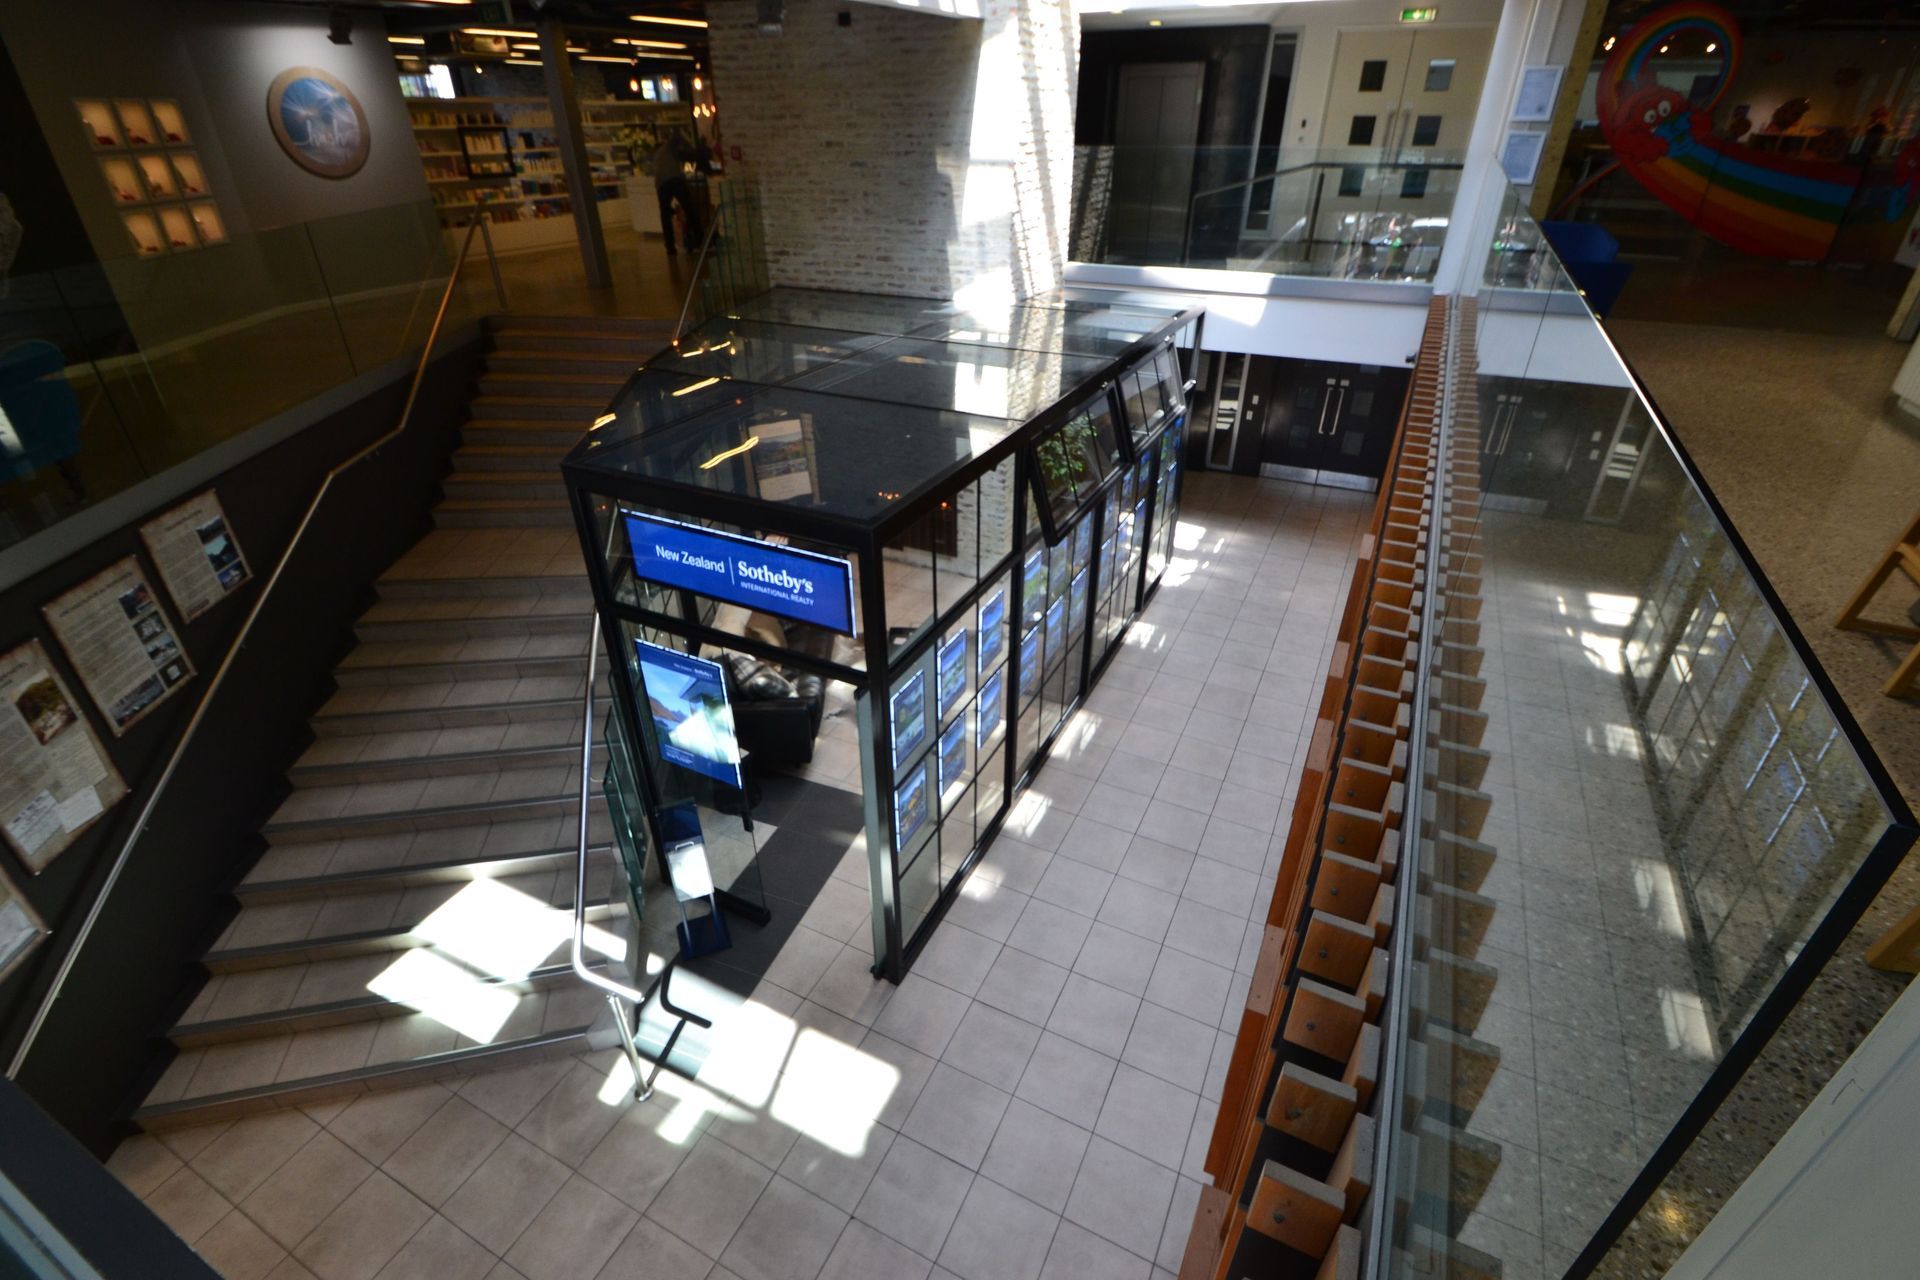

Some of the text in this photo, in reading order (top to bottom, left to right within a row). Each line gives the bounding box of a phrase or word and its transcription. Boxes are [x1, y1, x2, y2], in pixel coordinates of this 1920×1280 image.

[655, 544, 814, 594] New Zealand Sotheby's
[740, 581, 815, 606] INTERNATIONAL REALTY
